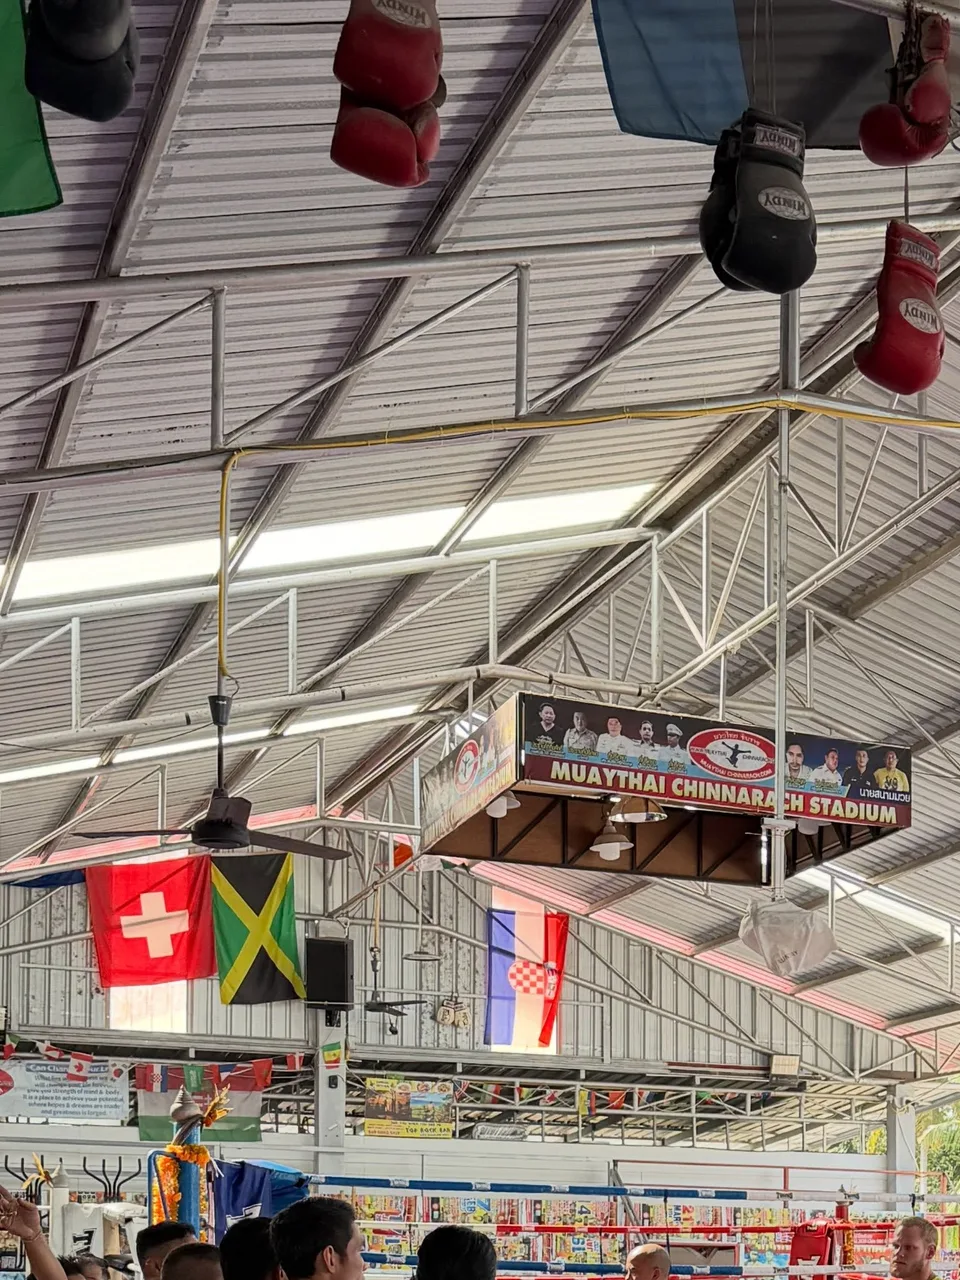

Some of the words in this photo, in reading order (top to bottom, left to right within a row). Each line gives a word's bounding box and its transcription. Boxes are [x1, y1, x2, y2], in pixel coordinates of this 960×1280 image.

[763, 192, 807, 217] WINDY
[904, 303, 938, 330] WINDY
[550, 760, 666, 794] MUAYTHAI
[809, 796, 898, 825] STADIUM
